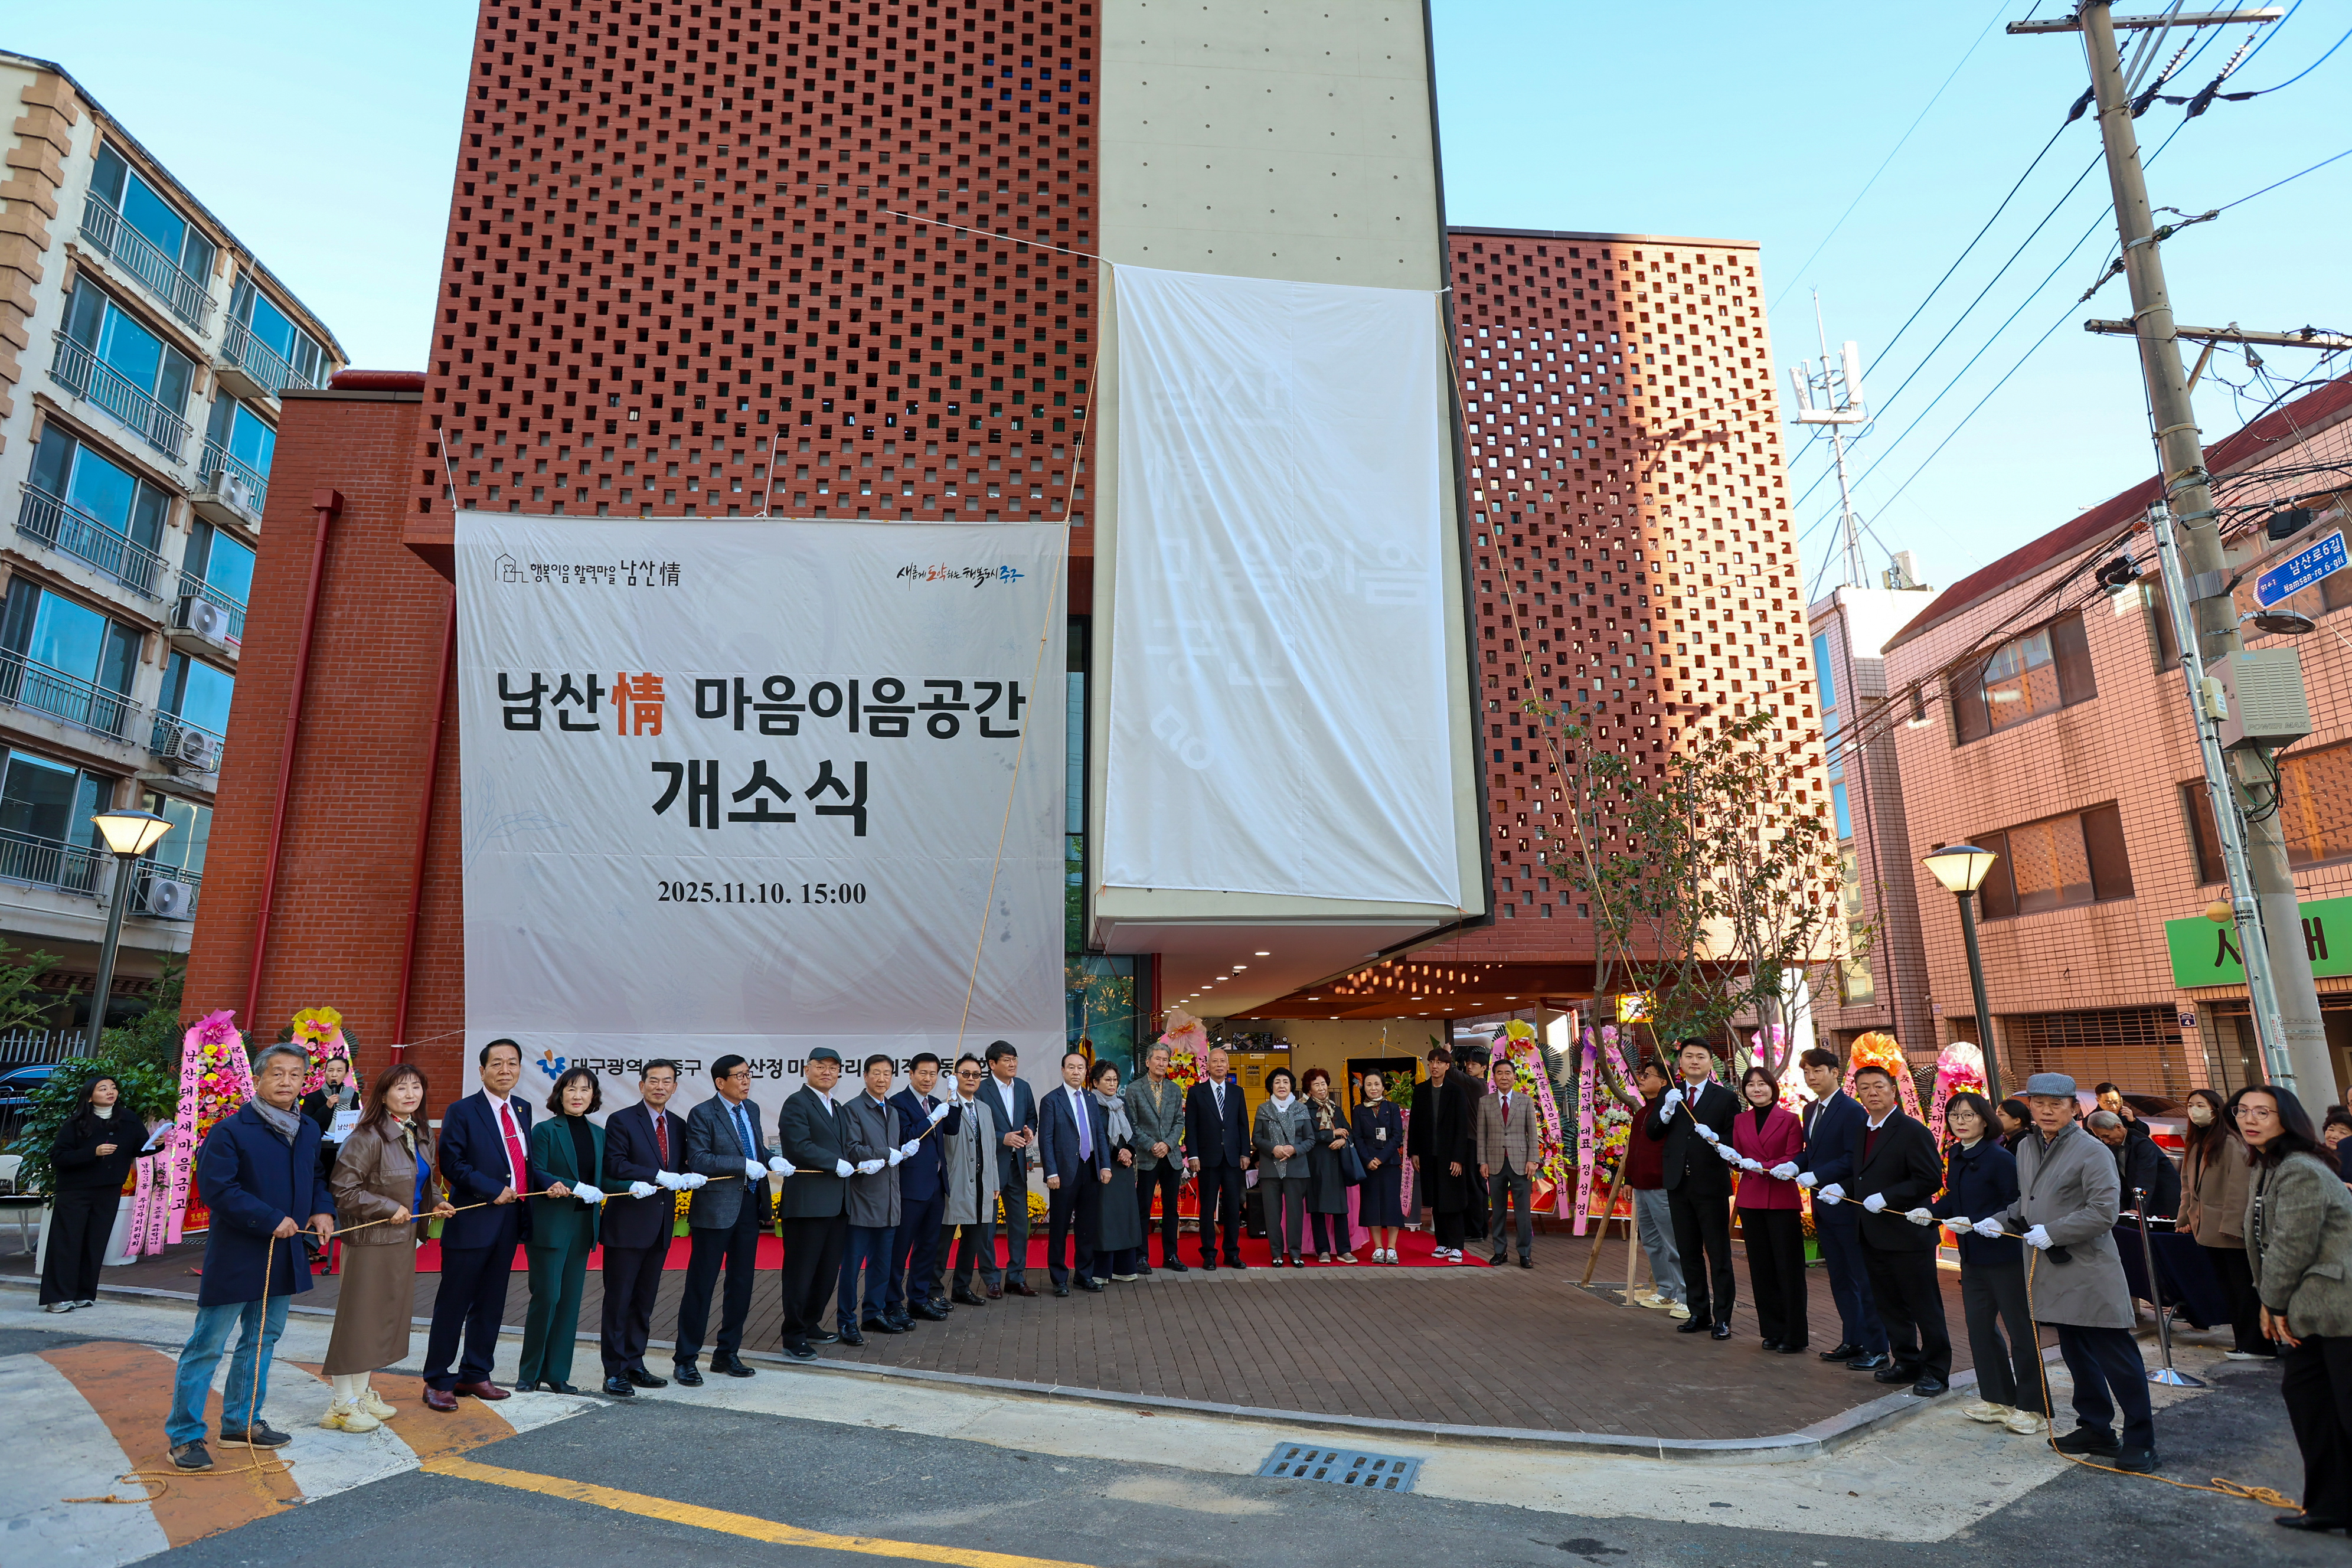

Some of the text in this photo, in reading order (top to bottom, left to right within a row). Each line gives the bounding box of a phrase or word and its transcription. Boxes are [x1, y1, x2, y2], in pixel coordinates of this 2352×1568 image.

[530, 560, 681, 587] 행복이음 활력마을 남산情
[2289, 538, 2341, 576] 남산로6길
[896, 562, 1025, 591] 새롭게 도약하는 행복도시 중구
[2284, 555, 2344, 593] Namsan-ro 6-gil
[498, 672, 1026, 740] 남산情 마음이음공간
[2248, 721, 2307, 731] POWER MAX
[651, 759, 868, 837] 개소식
[658, 881, 866, 904] 2025.11.10. 15:00
[571, 1058, 652, 1076] 대구광역
[1900, 1074, 1909, 1083] 축
[1532, 1061, 1546, 1090] 개소를
[1541, 1093, 1559, 1131] 진심으로
[1580, 1068, 1592, 1112] 예스인쇄
[172, 1050, 198, 1210] 남산대신새마을금고
[1580, 1126, 1592, 1149] 대표
[131, 1162, 150, 1247] 남산3동 주민자치위원회
[150, 1223, 161, 1246] 축하합니다
